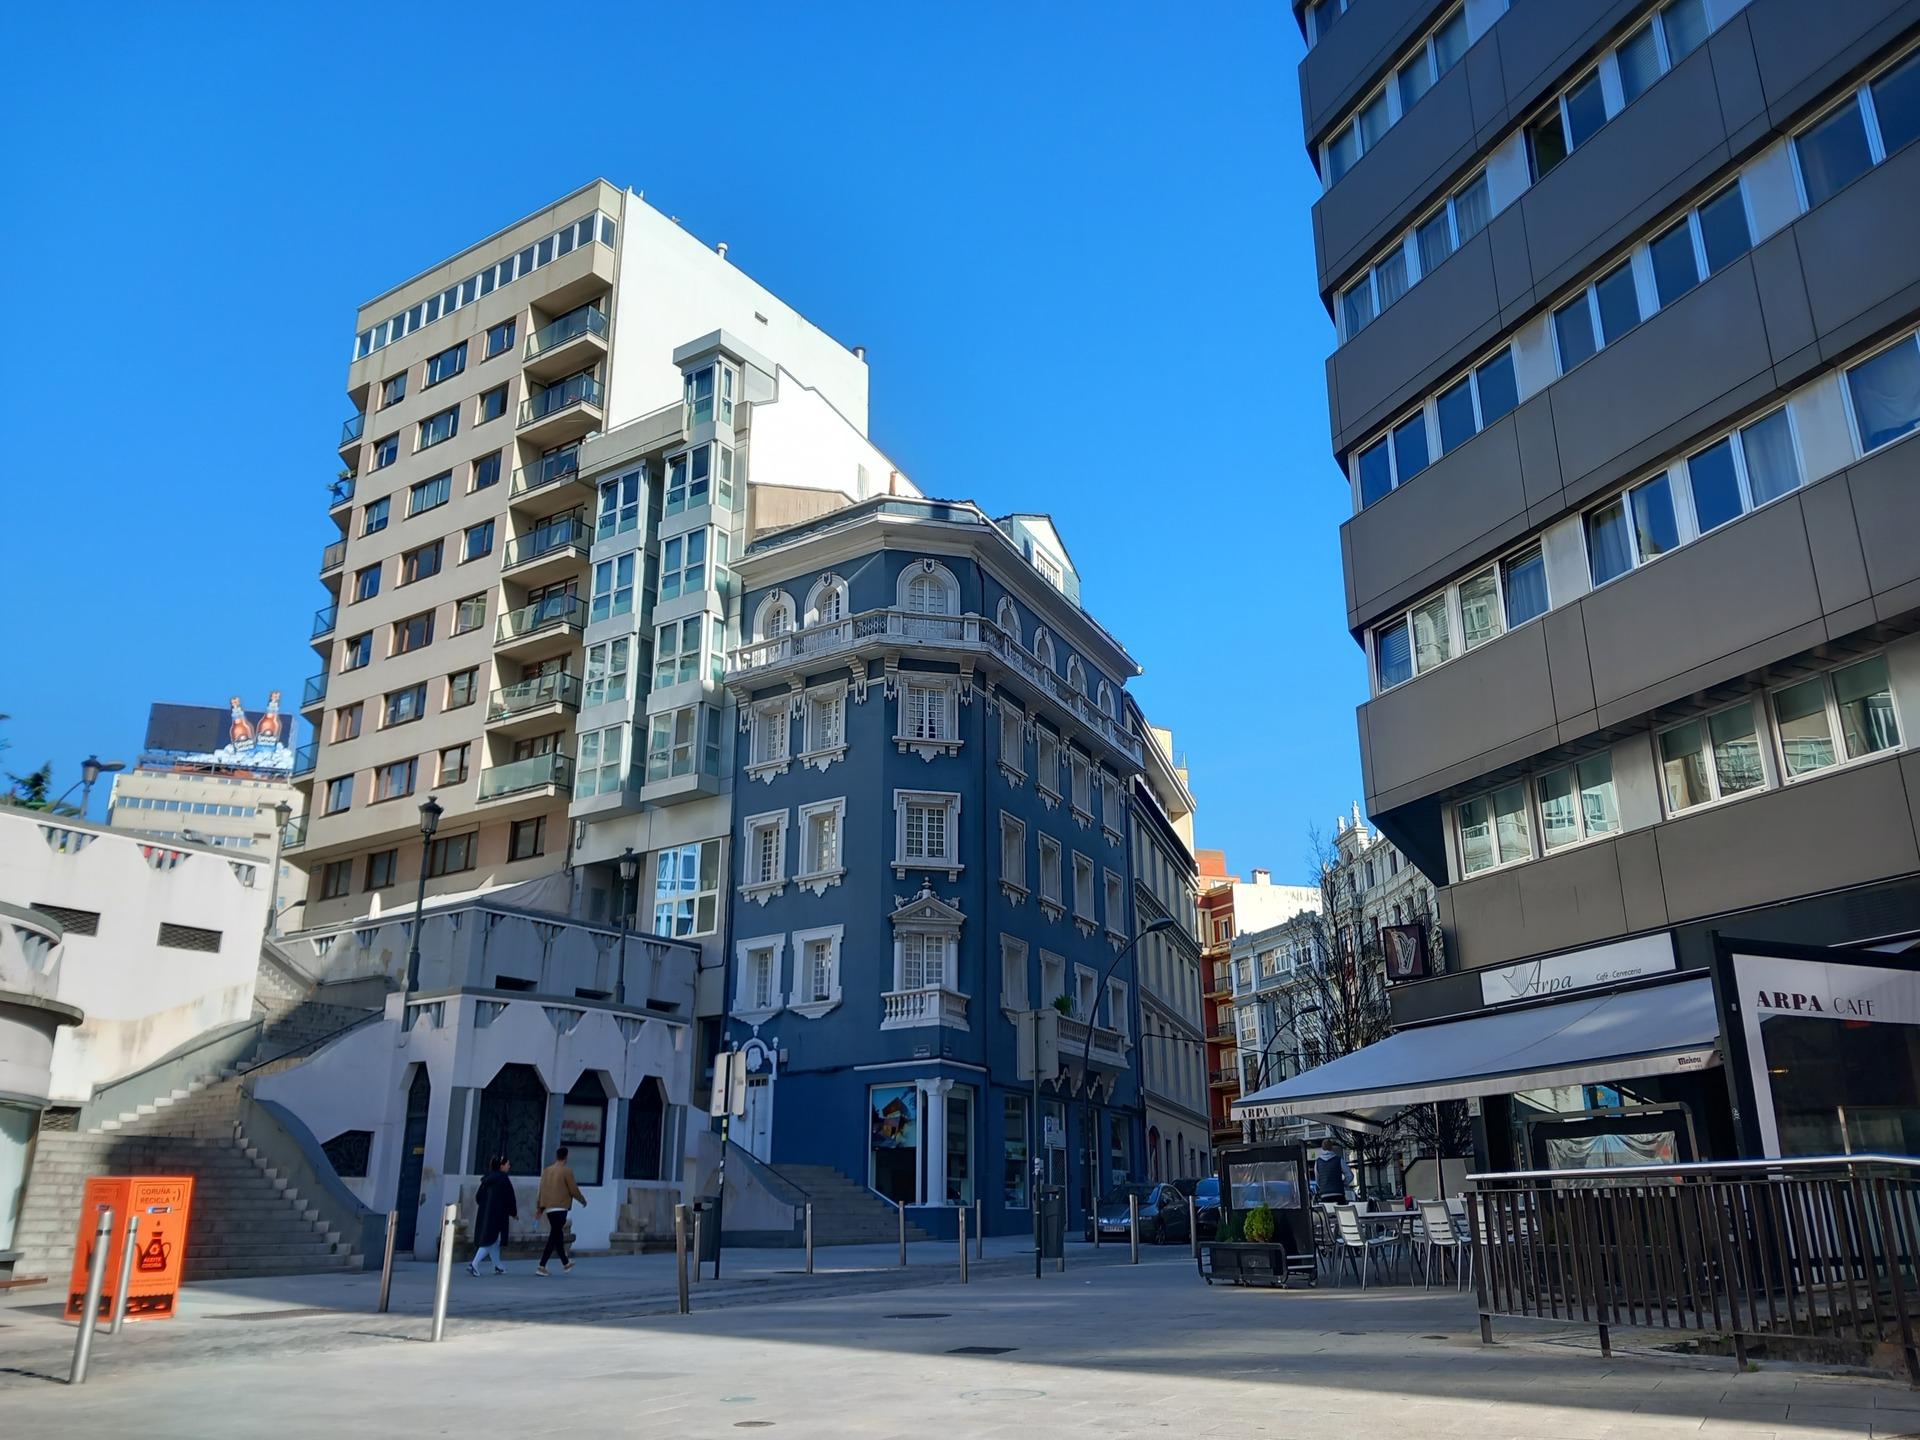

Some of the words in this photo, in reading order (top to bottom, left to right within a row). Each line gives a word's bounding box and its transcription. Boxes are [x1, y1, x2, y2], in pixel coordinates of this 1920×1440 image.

[1511, 959, 1573, 998] Arpa
[1757, 990, 1824, 1012] ARPA
[1833, 997, 1875, 1017] CAFE
[1240, 1106, 1269, 1118] ARPA
